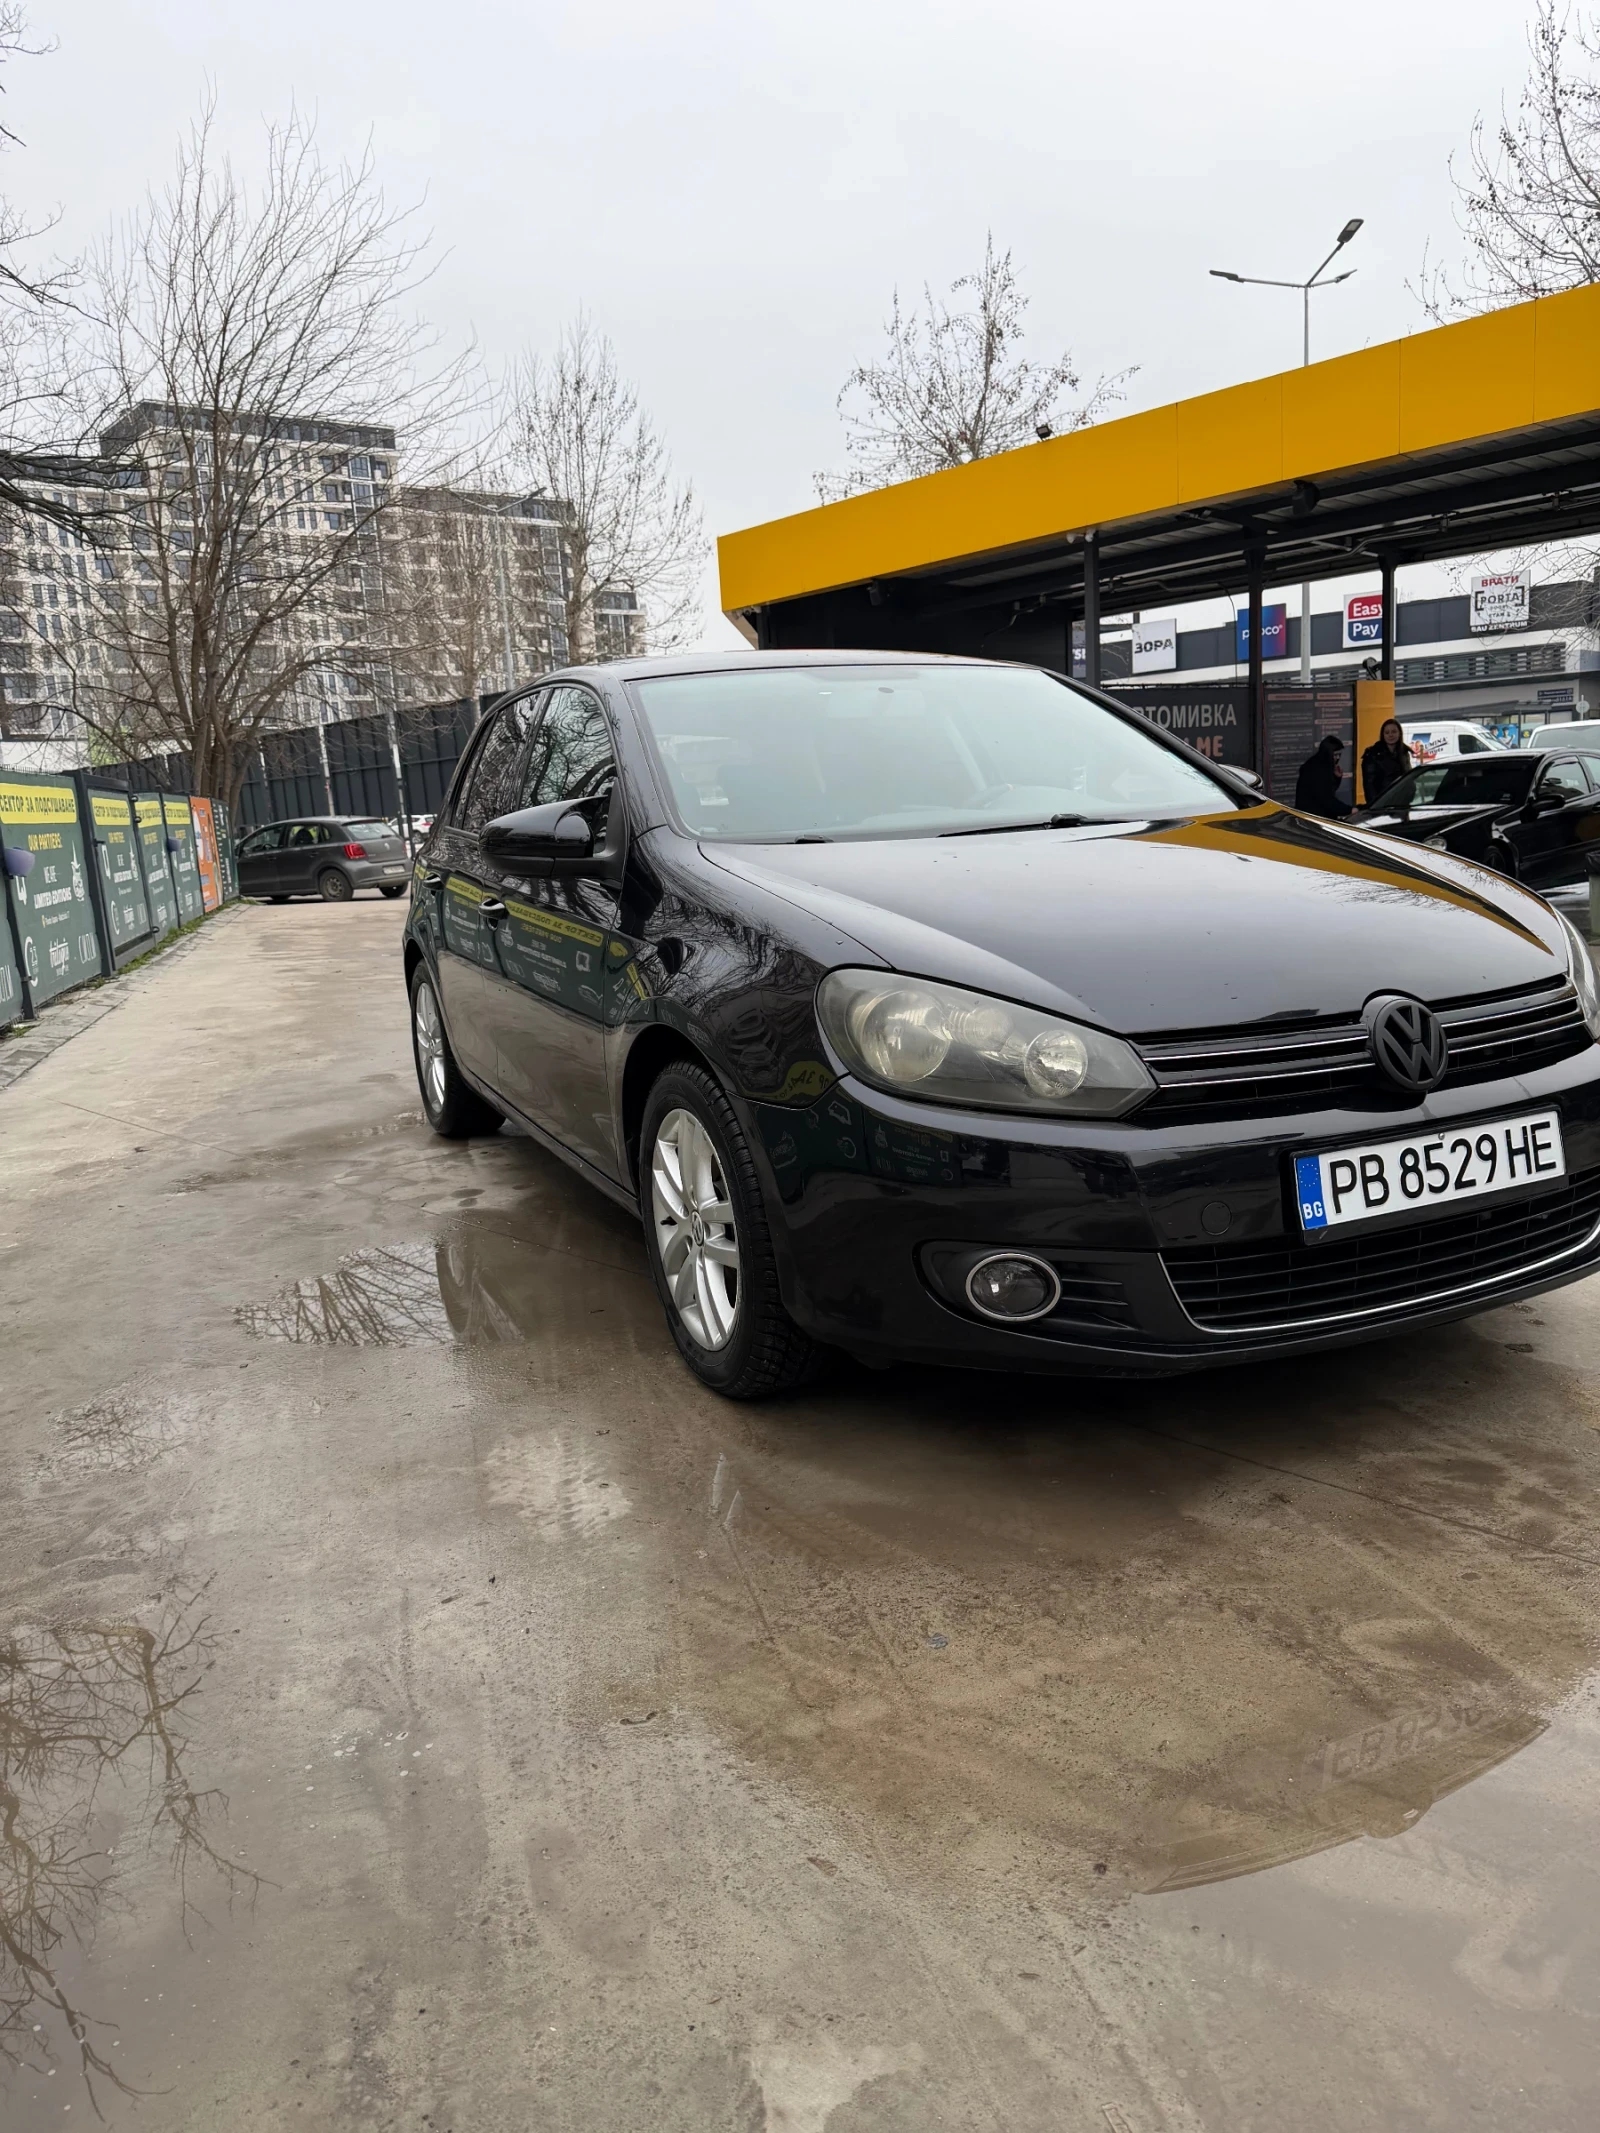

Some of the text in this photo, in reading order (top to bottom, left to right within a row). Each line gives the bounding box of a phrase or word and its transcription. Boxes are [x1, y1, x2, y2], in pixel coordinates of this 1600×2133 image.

[1481, 575, 1519, 587] ВРАТИ
[1480, 592, 1520, 605] PORTA
[1242, 625, 1281, 640] pco
[1352, 622, 1379, 638] Pay
[1488, 621, 1528, 631] ZENTRUM
[1134, 638, 1174, 654] ЗОРА
[25, 796, 35, 812] ЗА
[1328, 1120, 1557, 1215] PB 8529 HE
[1302, 1200, 1324, 1220] BG
